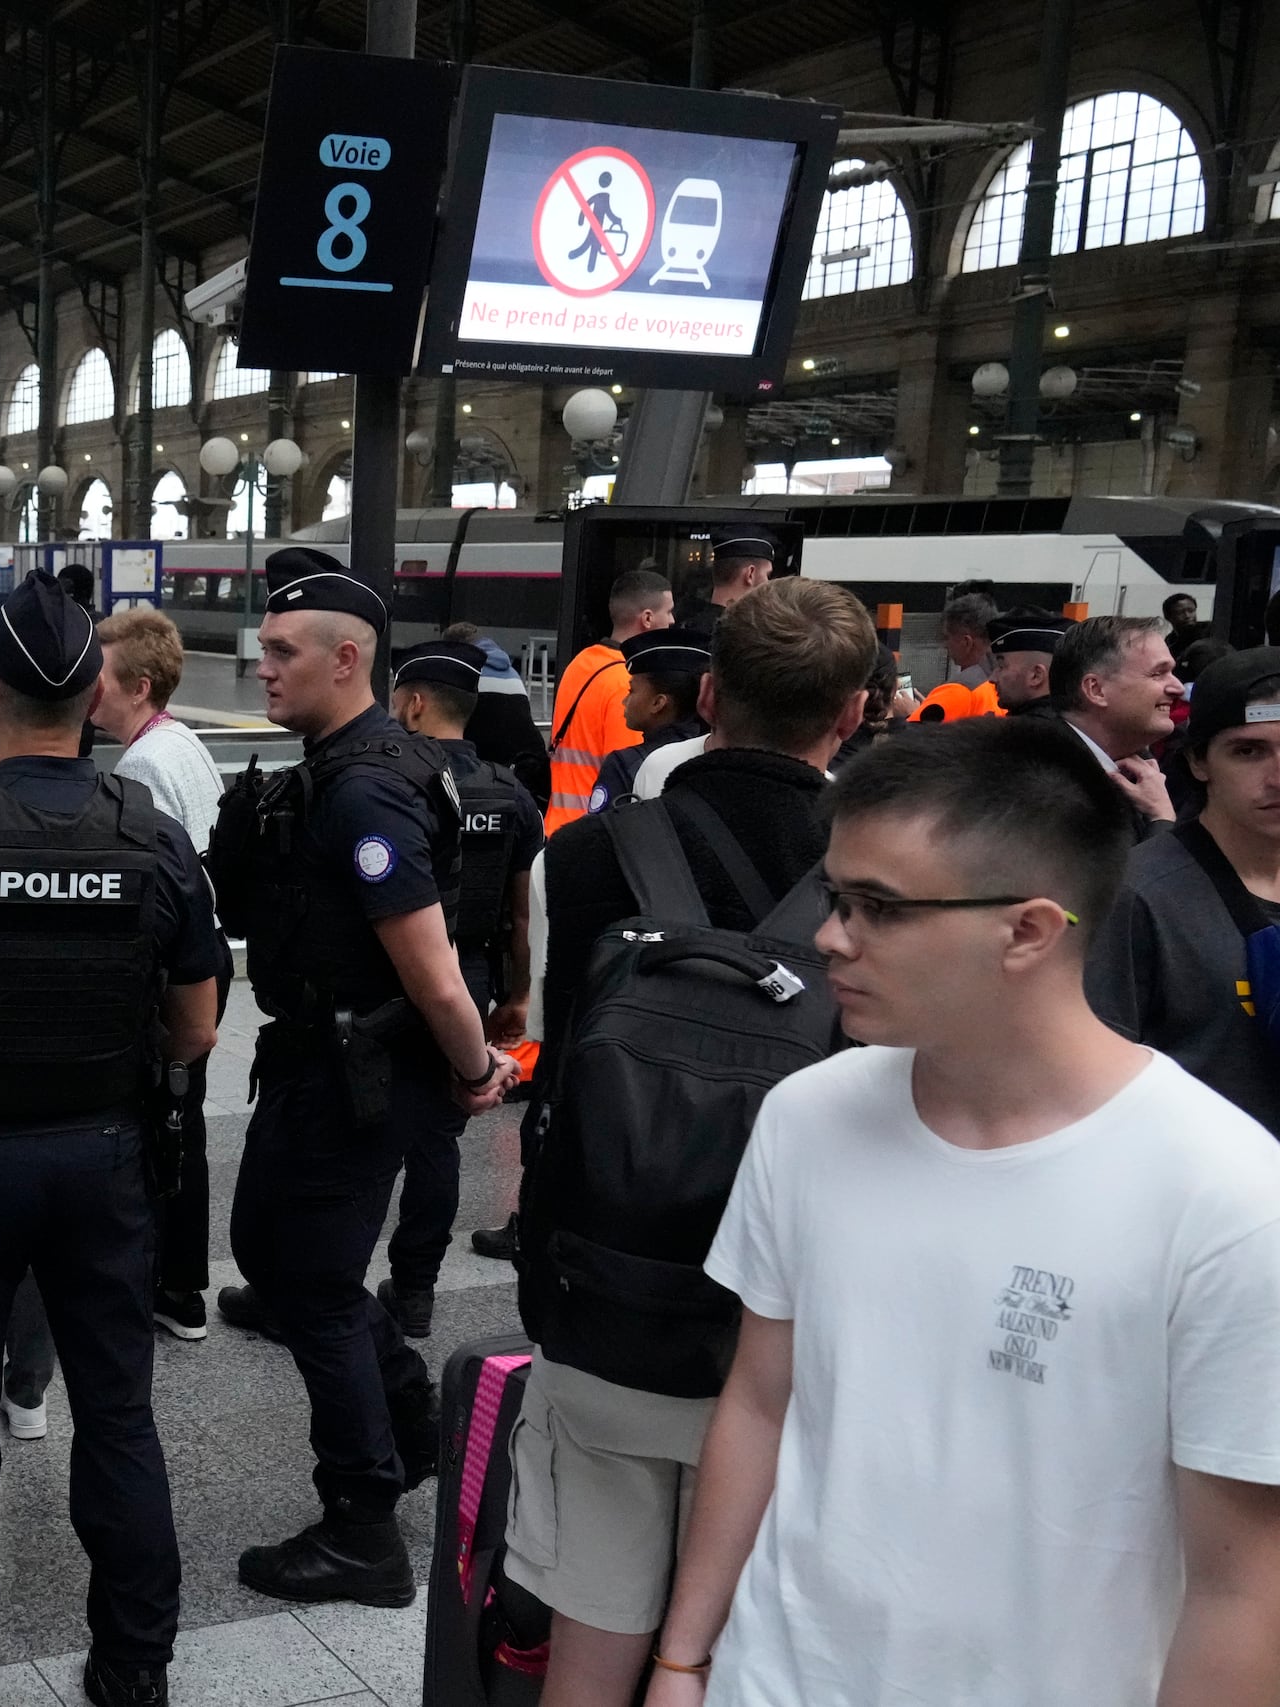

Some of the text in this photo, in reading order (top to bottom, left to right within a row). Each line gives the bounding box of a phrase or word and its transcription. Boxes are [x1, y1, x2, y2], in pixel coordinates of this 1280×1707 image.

[330, 138, 380, 166] Voie
[317, 182, 371, 272] 8
[470, 302, 744, 341] Ne prend pas de voyageurs
[454, 359, 486, 369] Présence
[486, 361, 491, 369] à
[508, 361, 544, 373] obligatoire
[544, 364, 550, 372] 2
[550, 364, 563, 373] min
[564, 366, 583, 374] avant
[584, 366, 591, 375] le
[592, 367, 614, 377] départ
[0, 871, 122, 899] POLICE
[1011, 1265, 1074, 1301] TREND
[1004, 1333, 1037, 1360] OSLO
